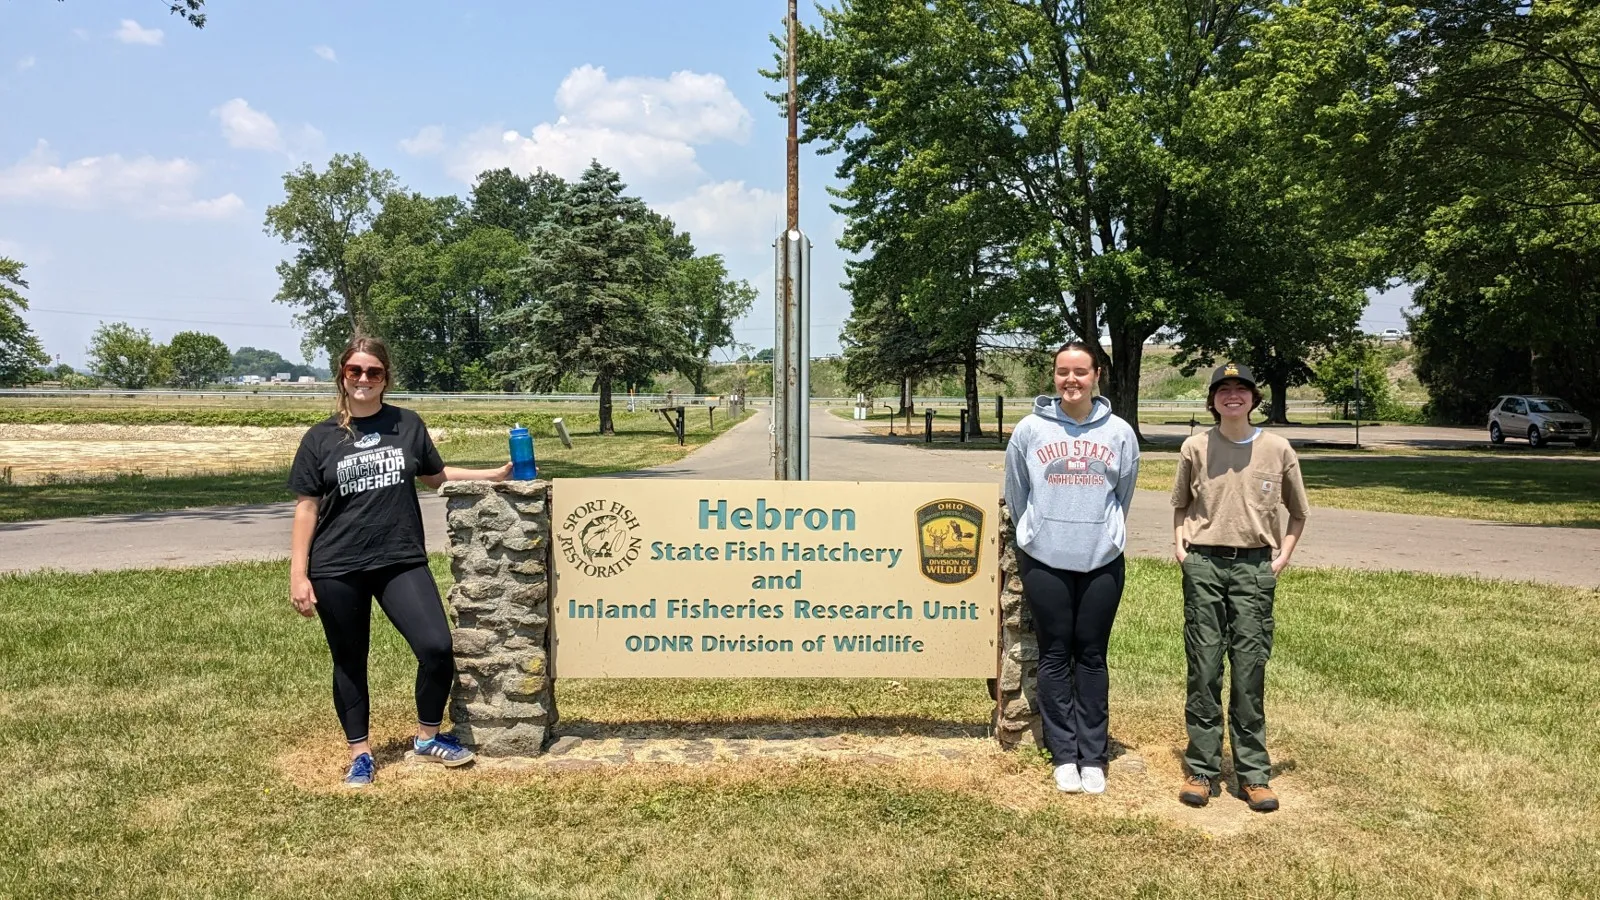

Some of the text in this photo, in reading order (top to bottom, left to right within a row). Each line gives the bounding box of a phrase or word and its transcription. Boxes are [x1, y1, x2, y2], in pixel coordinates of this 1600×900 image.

[337, 457, 358, 471] JUST
[359, 451, 386, 463] WHAT
[387, 448, 404, 457] THE
[1036, 441, 1068, 464] OHIO
[1073, 440, 1115, 466] STATE
[340, 471, 405, 497] ORDERED.
[1047, 474, 1104, 485] ATHLETICS
[563, 499, 641, 532] SPORT FISH
[698, 498, 856, 531] Hebron
[560, 536, 643, 578] RESTORATION
[650, 541, 903, 568] State Fish Hatchery
[751, 570, 802, 590] and
[926, 565, 974, 574] WILDLIFE
[568, 599, 980, 620] Inland Fisheries Research Unit
[625, 635, 925, 653] ODNR Division of Wildlife
